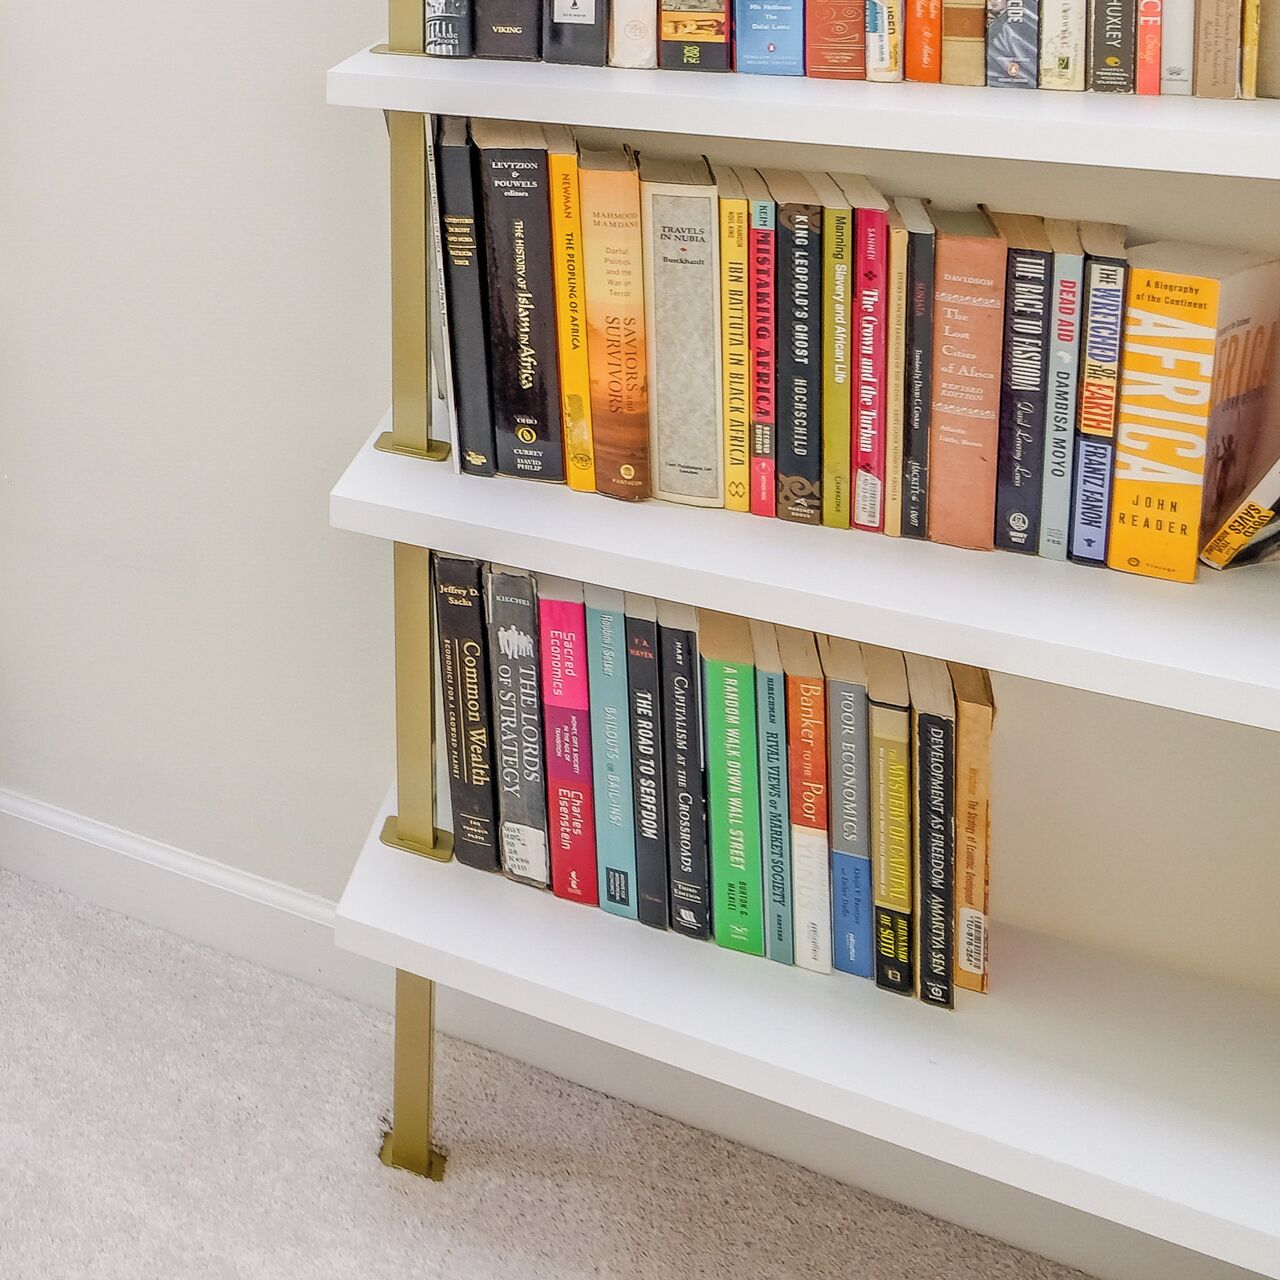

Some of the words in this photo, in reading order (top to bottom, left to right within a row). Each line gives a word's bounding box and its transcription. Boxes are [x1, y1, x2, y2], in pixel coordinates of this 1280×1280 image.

[492, 25, 522, 34] VIKING
[494, 180, 537, 188] POUWELS
[562, 174, 572, 219] NEWMAN
[565, 232, 573, 250] THE
[661, 226, 704, 235] TRAVELS
[567, 253, 576, 300] PEOPLING
[729, 261, 743, 283] IBN
[756, 232, 772, 341] MISTAKING
[1098, 268, 1118, 286] THE
[1145, 280, 1151, 288] A
[1154, 280, 1200, 295] Biography
[569, 302, 577, 316] OF
[728, 290, 744, 347] BATTUTA
[1059, 279, 1076, 318] DEAD
[1136, 293, 1144, 301] of
[1146, 294, 1160, 303] the
[1163, 295, 1208, 310] Continent
[570, 317, 579, 350] AFRICA
[1056, 319, 1074, 343] AID
[1087, 287, 1121, 364] WRETCHED
[605, 316, 623, 414] SURVIVORS
[729, 354, 743, 366] IN
[729, 372, 744, 413] BLACK
[756, 347, 771, 419] AFRICA
[1053, 371, 1070, 433] DAMBISA
[1116, 308, 1215, 486] AFRICA
[793, 378, 807, 457] HOCHSCHILD
[1083, 382, 1115, 433] EARTH
[729, 419, 744, 466] AFRICA
[1051, 436, 1067, 477] MOYO
[1082, 443, 1107, 492] FRANTZ
[1081, 492, 1104, 529] FANON
[1119, 513, 1189, 536] READER
[1131, 494, 1178, 513] JOHN
[550, 630, 563, 696] Economics
[563, 632, 576, 676] Sacred
[463, 641, 480, 722] Common
[498, 665, 511, 691] OF
[519, 665, 536, 709] THE
[637, 692, 651, 720] THE
[841, 691, 854, 736] POOR
[470, 727, 489, 787] Wealth
[499, 693, 521, 799] STRATEGY
[521, 713, 539, 782] LORDS
[637, 721, 654, 757] ROAD
[639, 759, 655, 776] TO
[570, 791, 583, 836] Charles
[640, 778, 657, 840] SERFDOM
[841, 742, 858, 841] ECONOMICS
